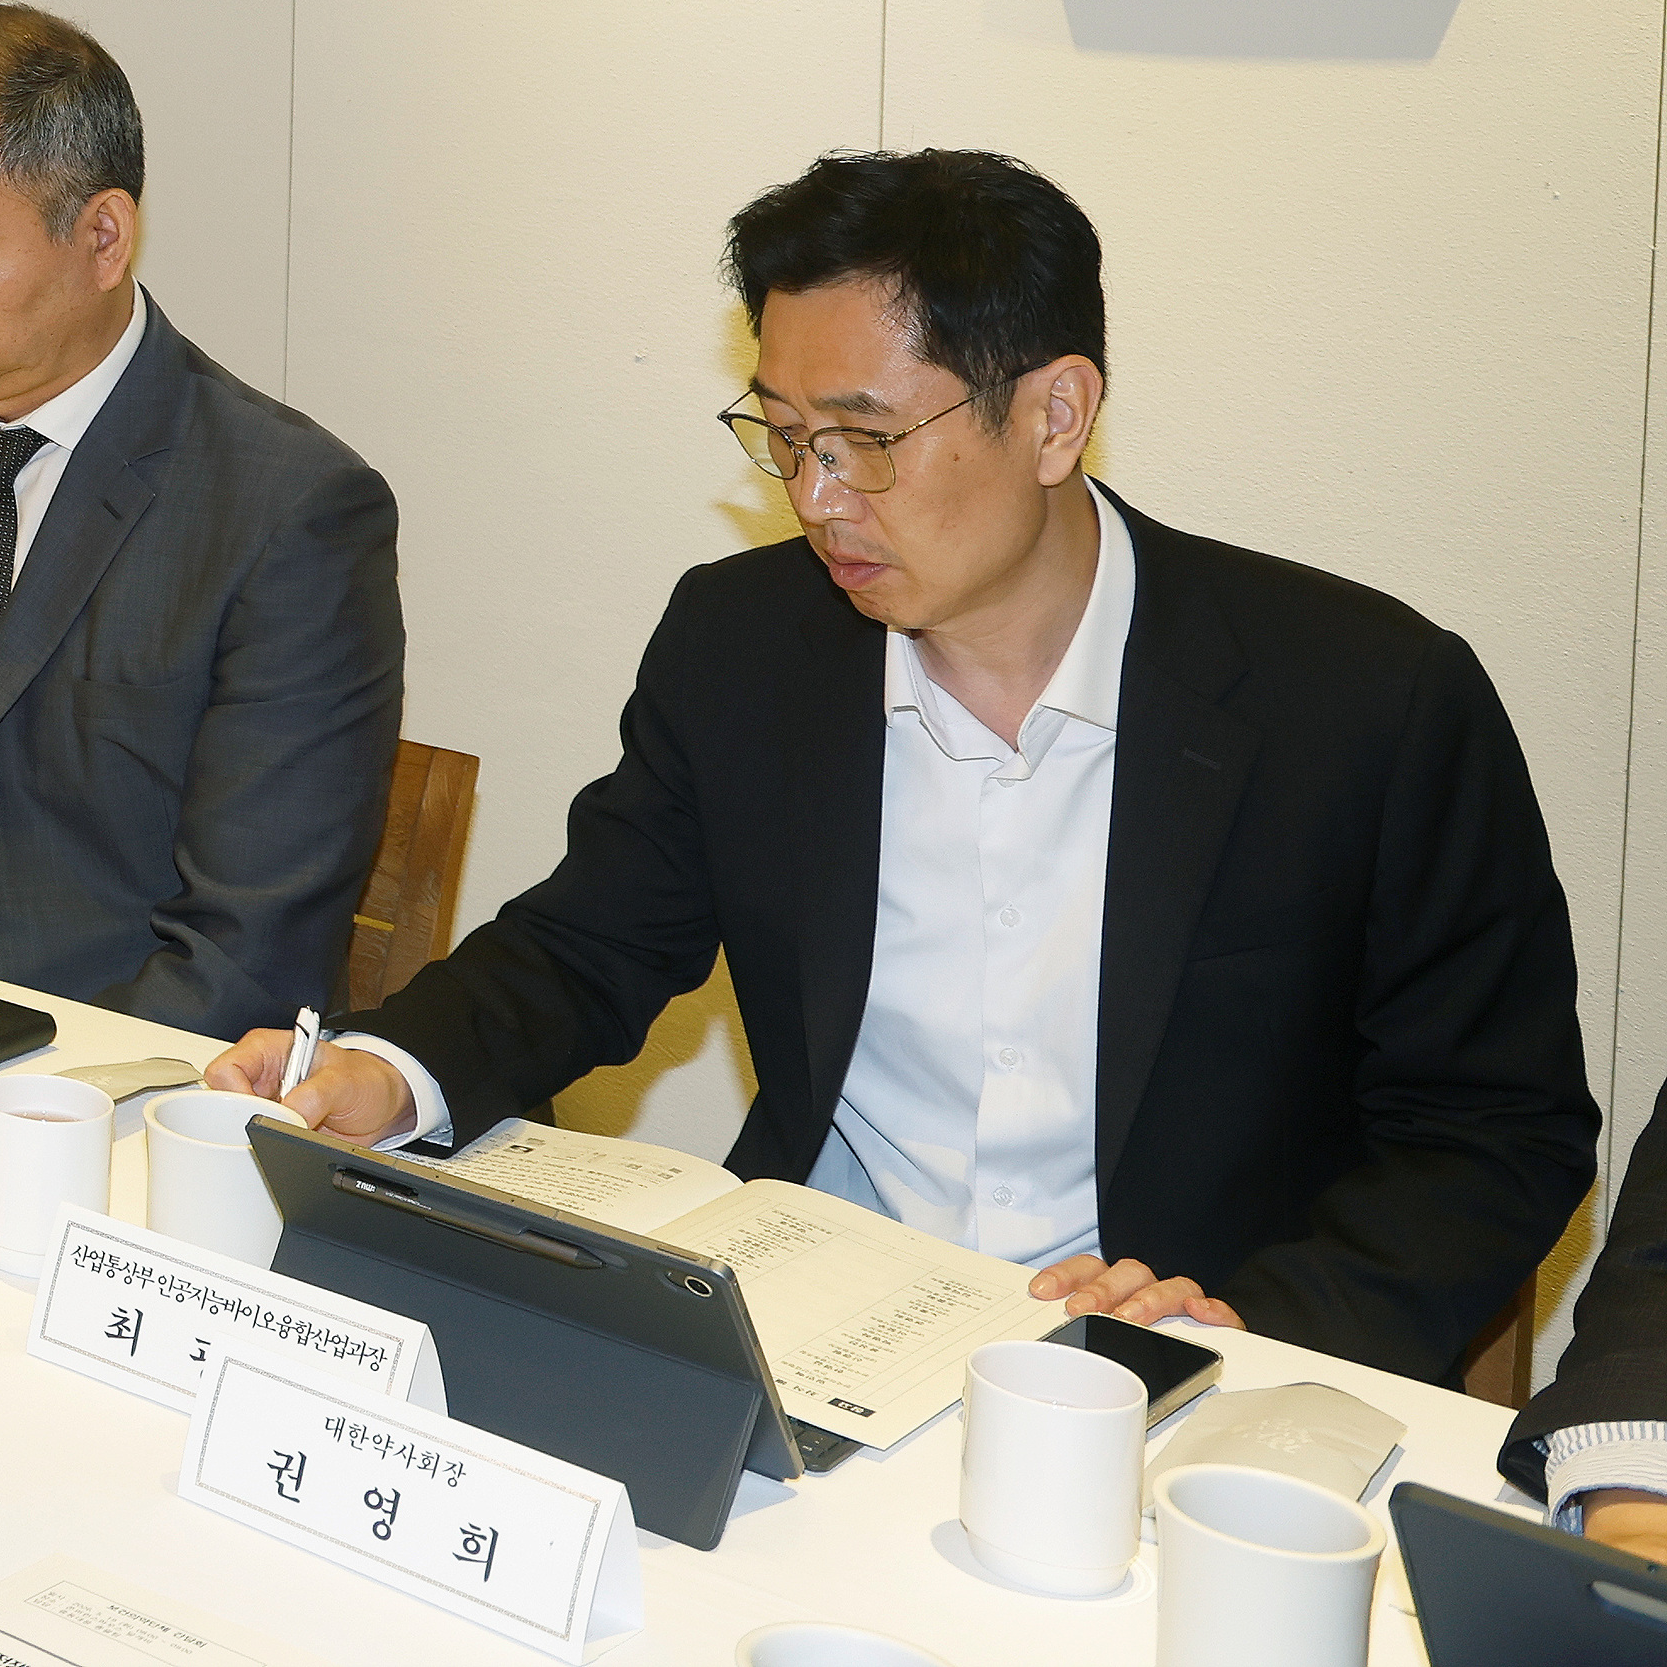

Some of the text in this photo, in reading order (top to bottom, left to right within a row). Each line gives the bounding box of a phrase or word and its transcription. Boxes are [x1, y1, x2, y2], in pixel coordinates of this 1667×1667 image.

[70, 1245, 155, 1290] 산업통상부
[157, 1274, 388, 1372] 인공지능바이오융합산업과장
[104, 1306, 144, 1357] 최
[324, 1416, 467, 1488] 대한약사회장
[267, 1449, 499, 1583] 권 영 희
